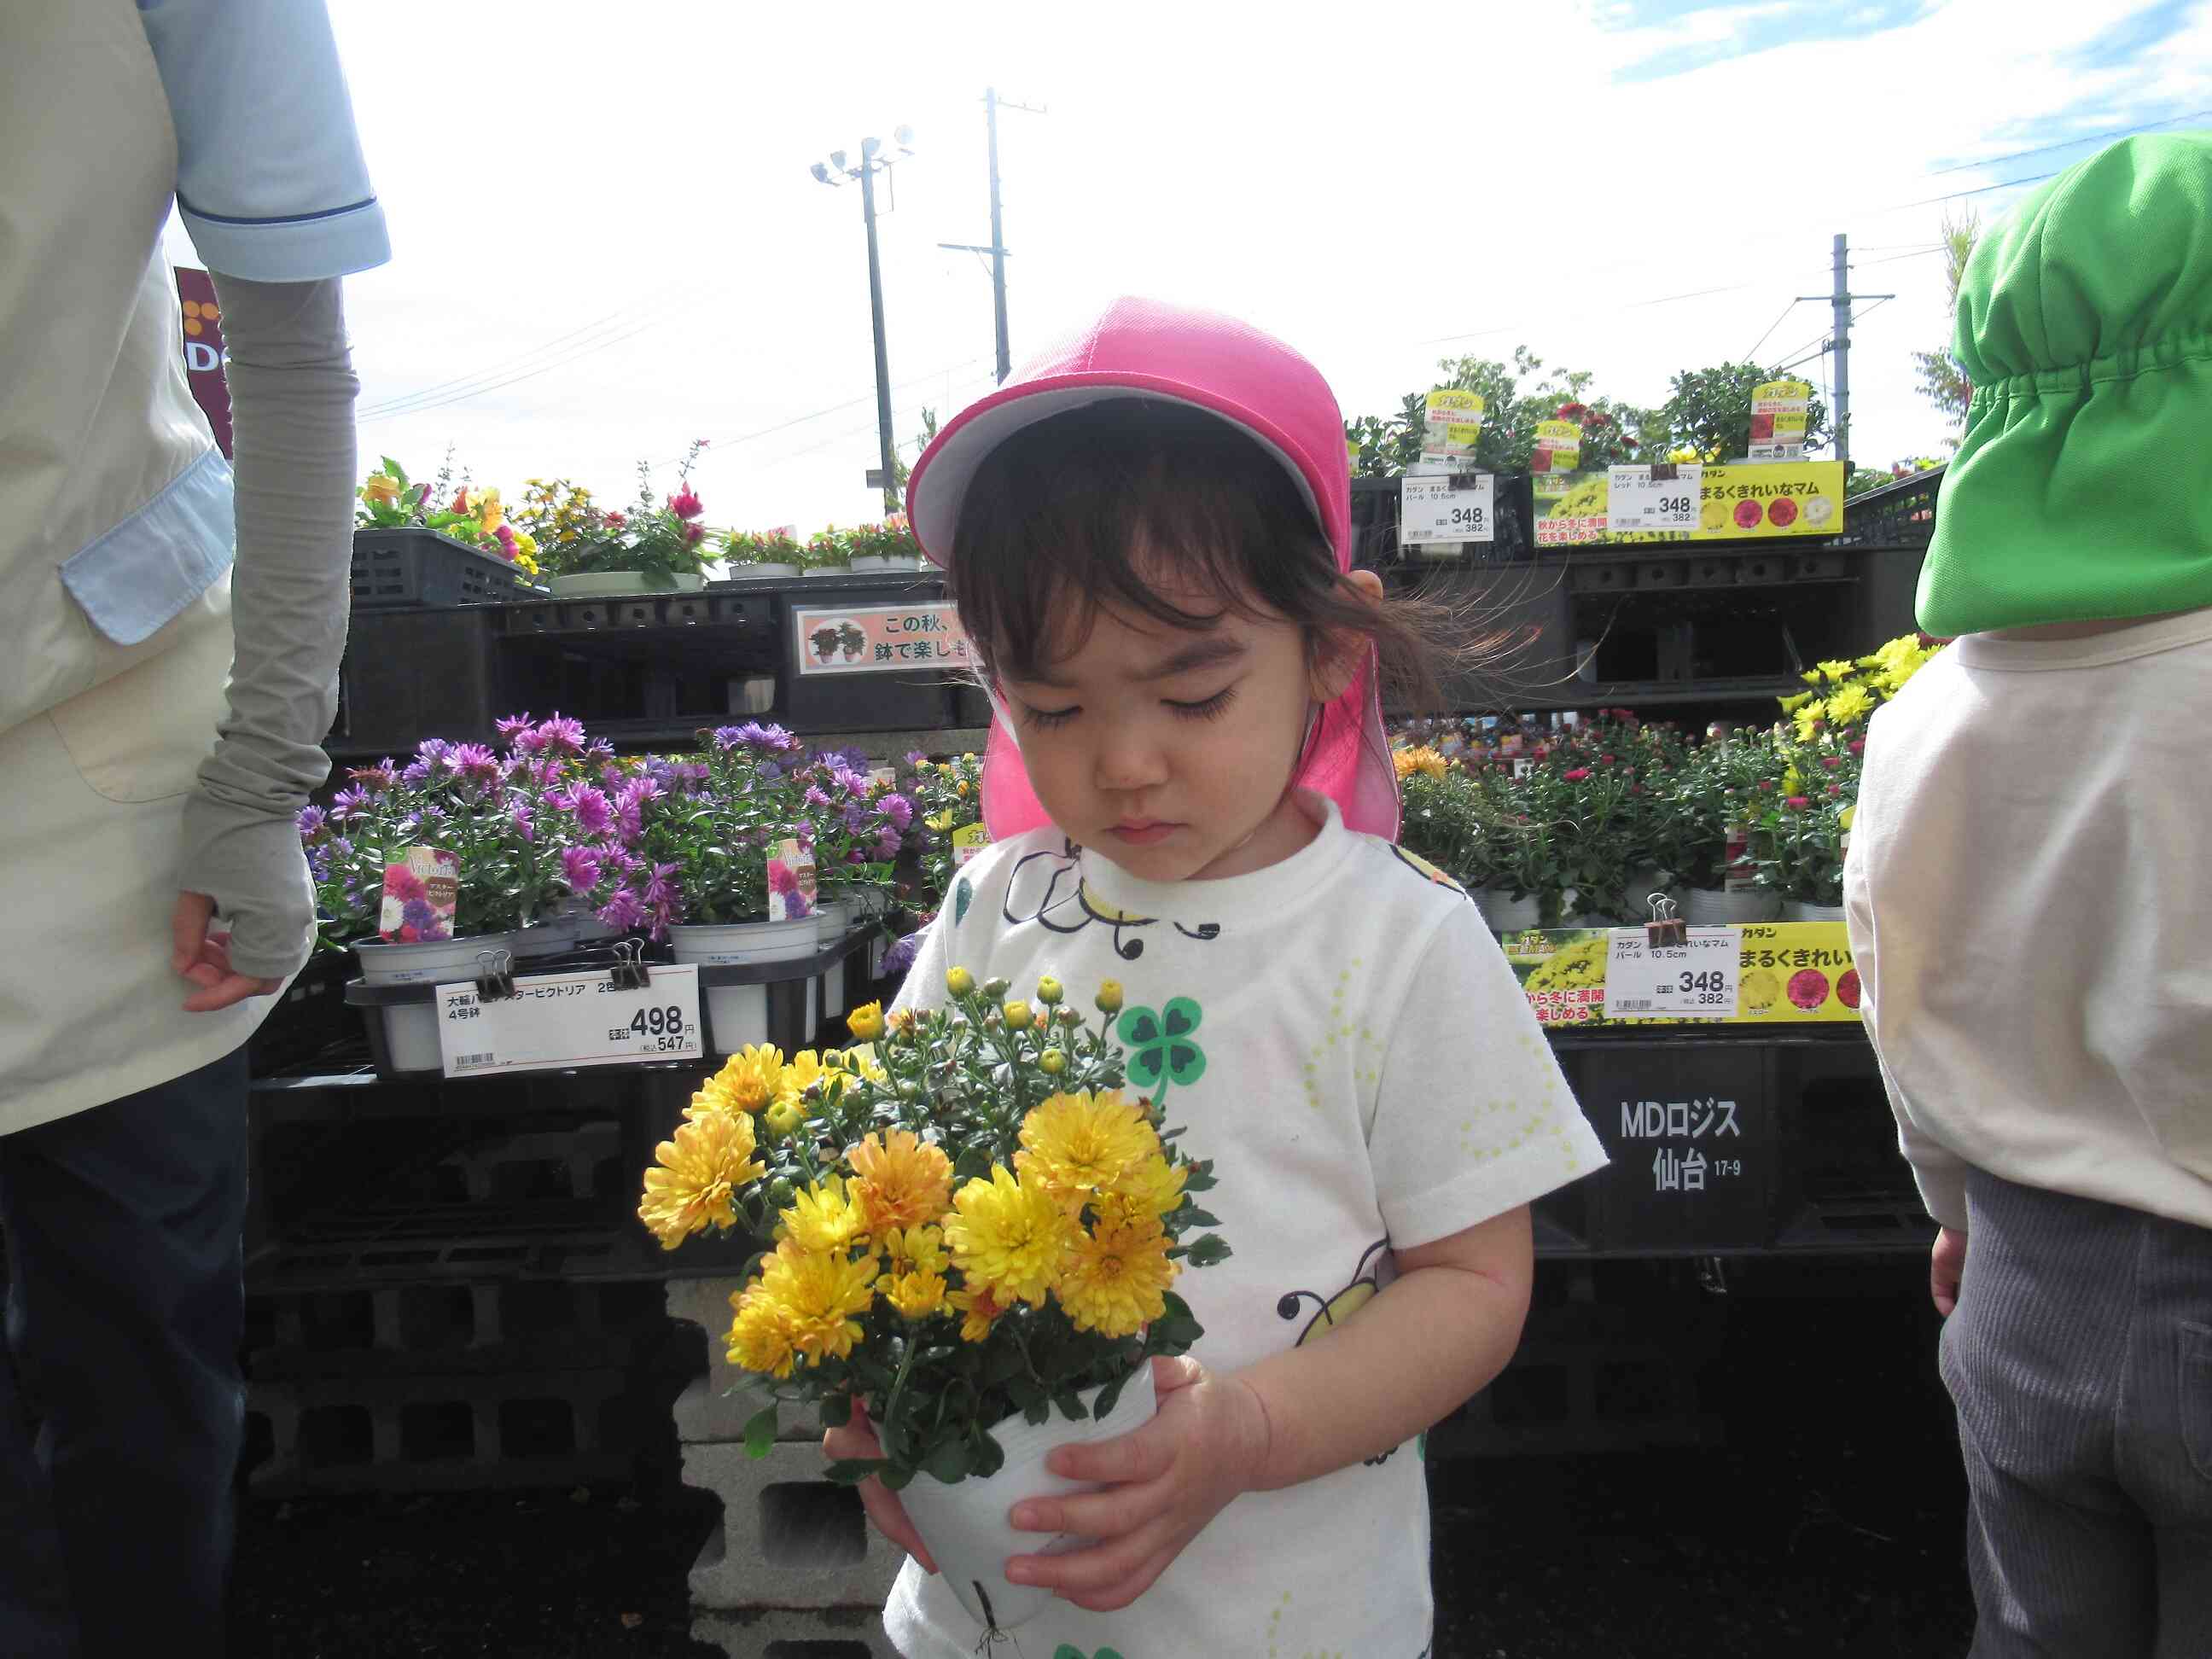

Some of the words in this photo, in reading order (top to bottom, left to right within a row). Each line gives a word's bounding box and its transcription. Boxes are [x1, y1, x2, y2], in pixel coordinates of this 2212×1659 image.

[1700, 482, 1819, 500] まるくきれいなマム
[885, 614, 949, 634] この秋、
[1741, 927, 1777, 939] カダン
[449, 1007, 480, 1020] 4号鉢
[1621, 1097, 1741, 1138] MDロジス
[1652, 1147, 1708, 1190] 仙台
[1714, 1160, 1741, 1176] 17-9
